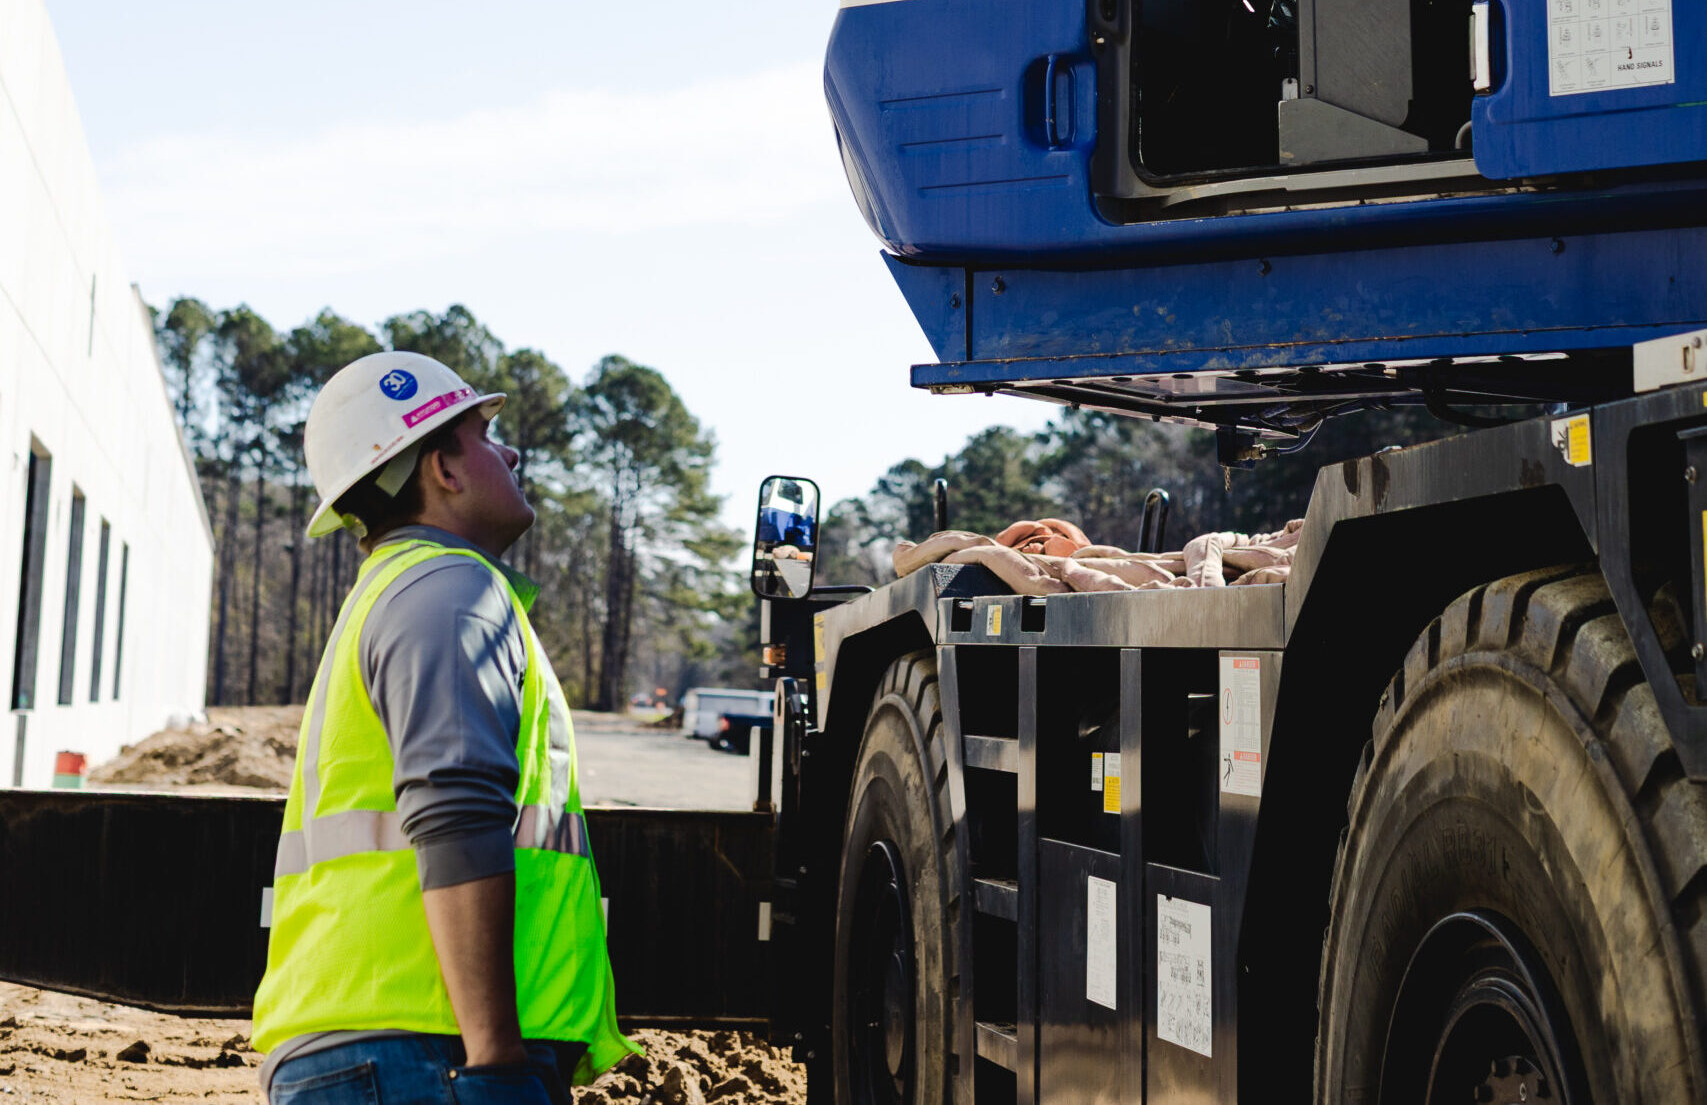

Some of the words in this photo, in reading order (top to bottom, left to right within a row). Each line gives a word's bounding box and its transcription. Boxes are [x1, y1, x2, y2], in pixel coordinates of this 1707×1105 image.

[1617, 62, 1635, 71] HAND
[1636, 60, 1663, 69] SIGNALS
[384, 372, 407, 392] 30
